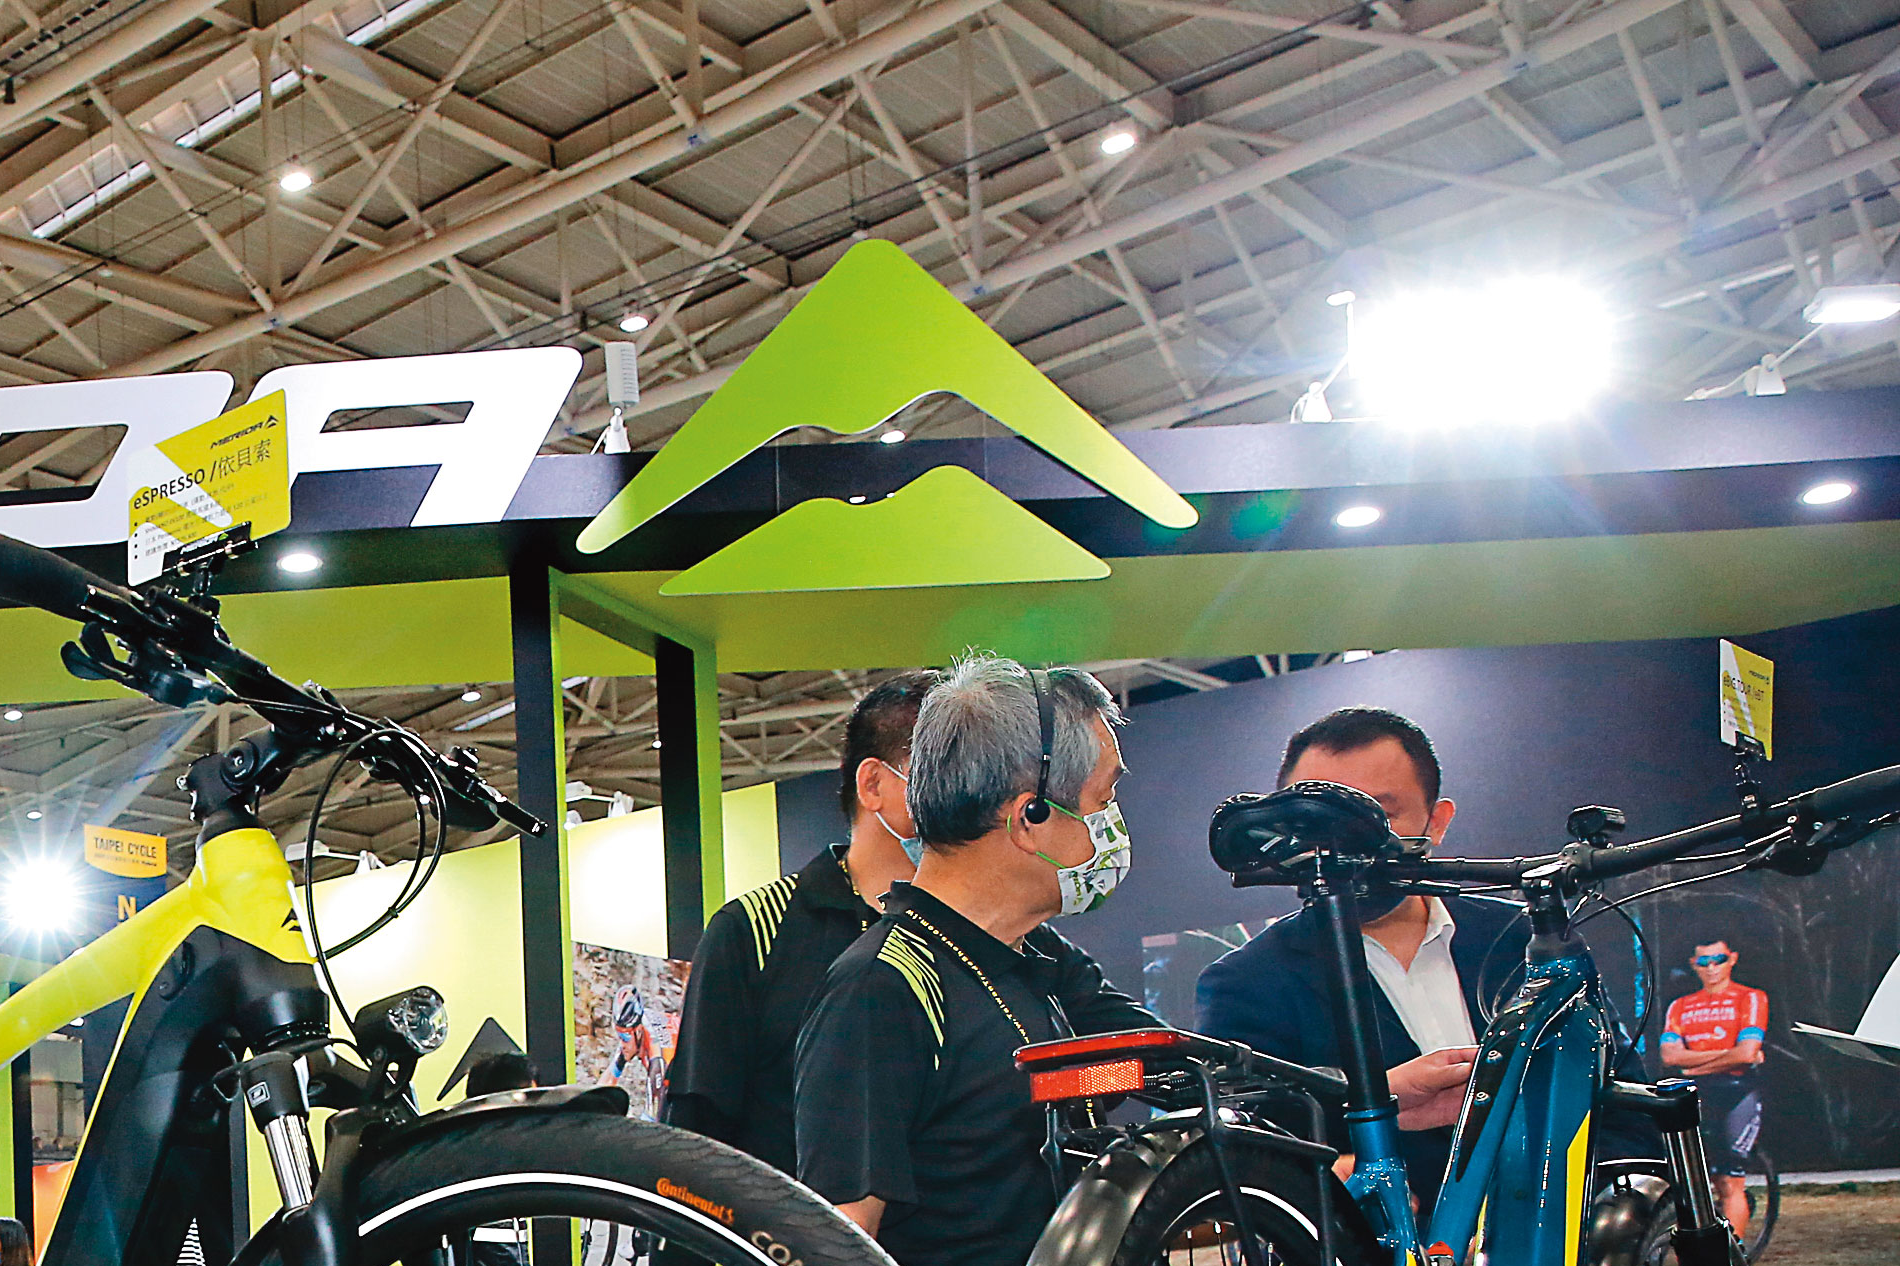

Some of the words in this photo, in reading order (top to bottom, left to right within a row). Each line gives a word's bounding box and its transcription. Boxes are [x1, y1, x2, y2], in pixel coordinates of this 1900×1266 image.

[210, 420, 264, 449] MERIDA
[134, 469, 205, 510] eSPRESSO
[94, 837, 123, 852] TAIPEI
[127, 842, 156, 858] CYCLE
[656, 1177, 725, 1220] Continental
